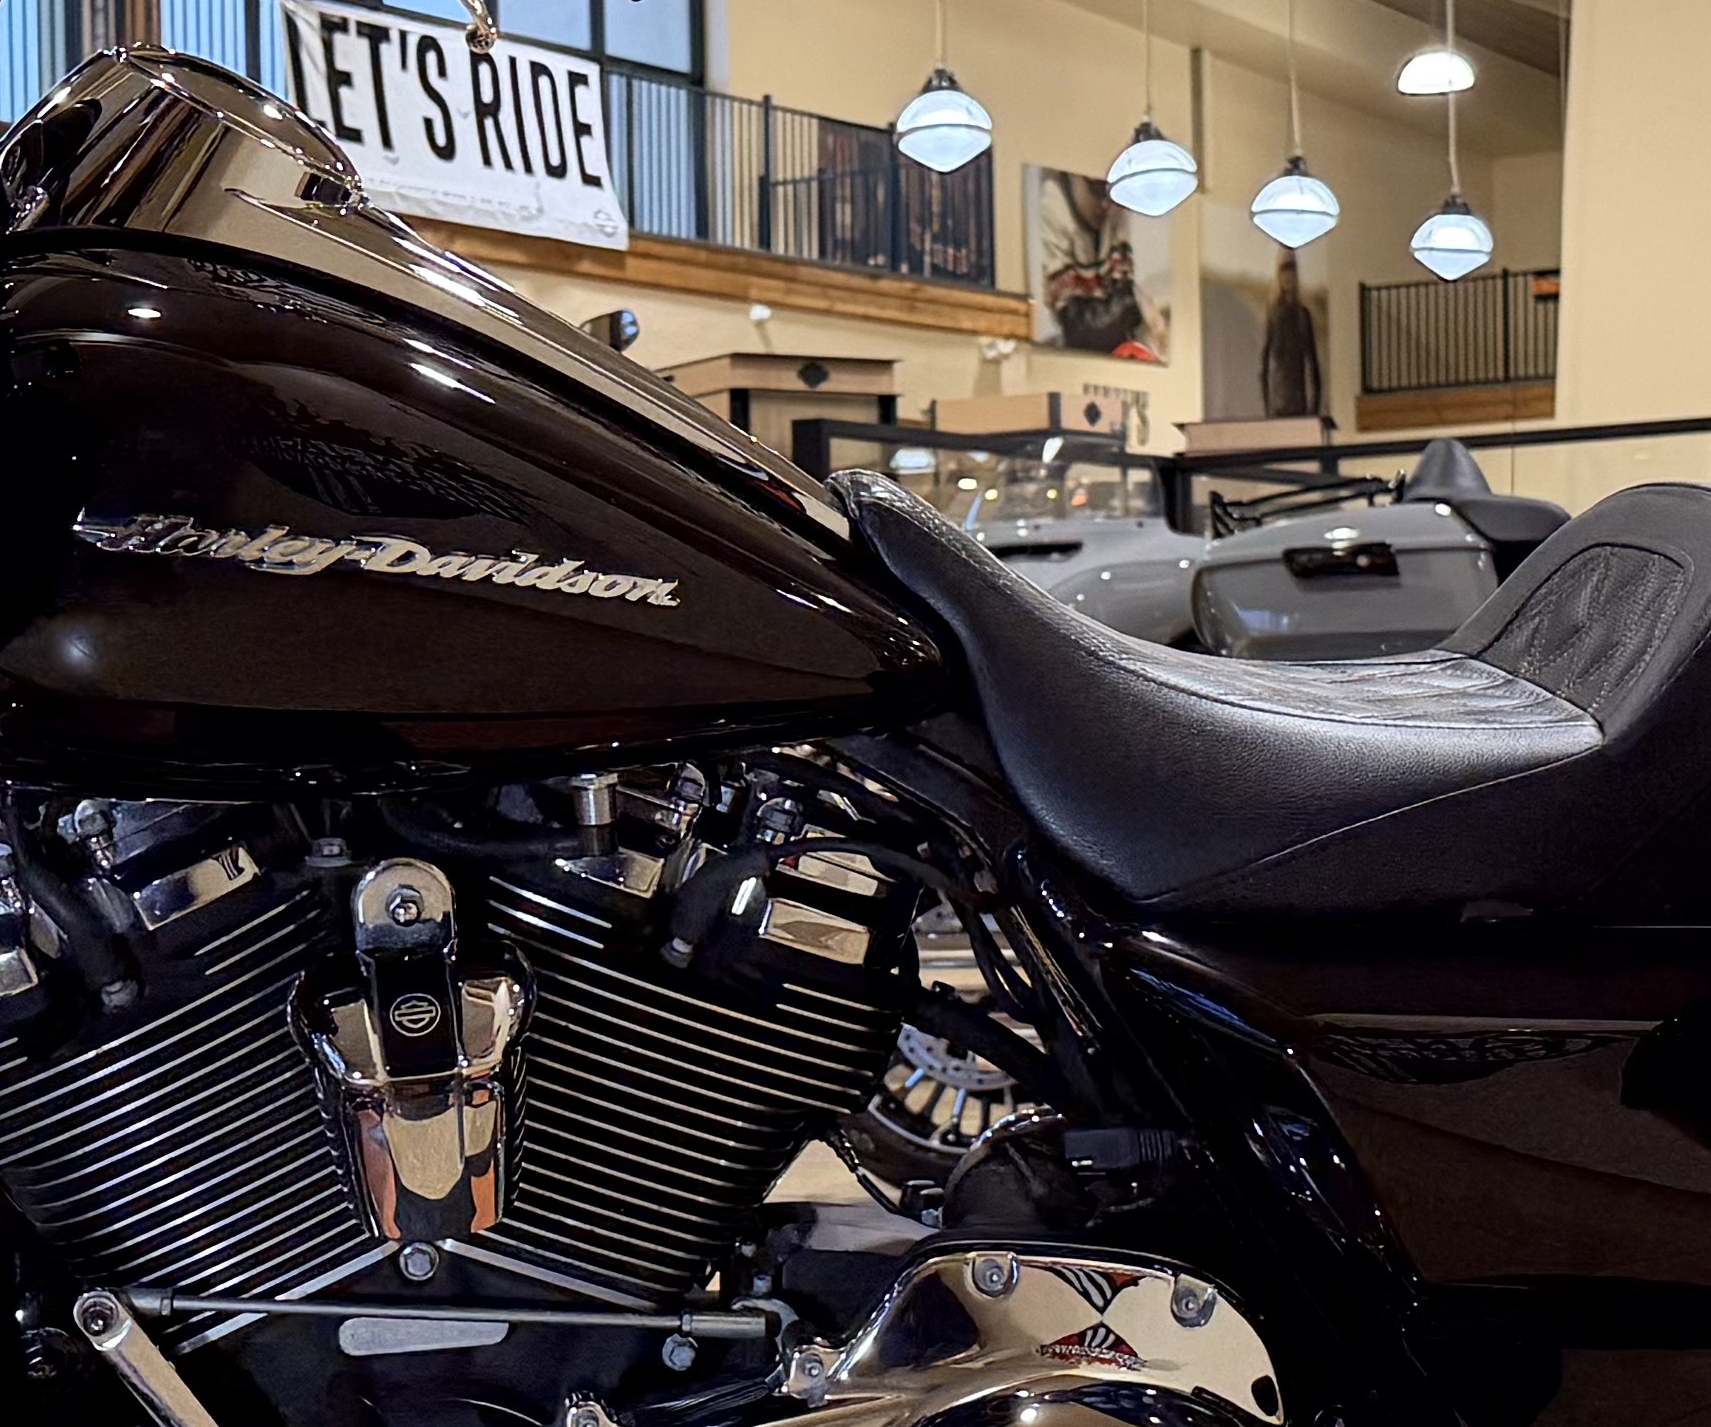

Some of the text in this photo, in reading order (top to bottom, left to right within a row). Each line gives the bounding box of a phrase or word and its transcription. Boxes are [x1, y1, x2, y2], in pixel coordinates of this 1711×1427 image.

[285, 10, 604, 190] LET'S RIDE
[73, 507, 681, 607] Harley-Davidson
